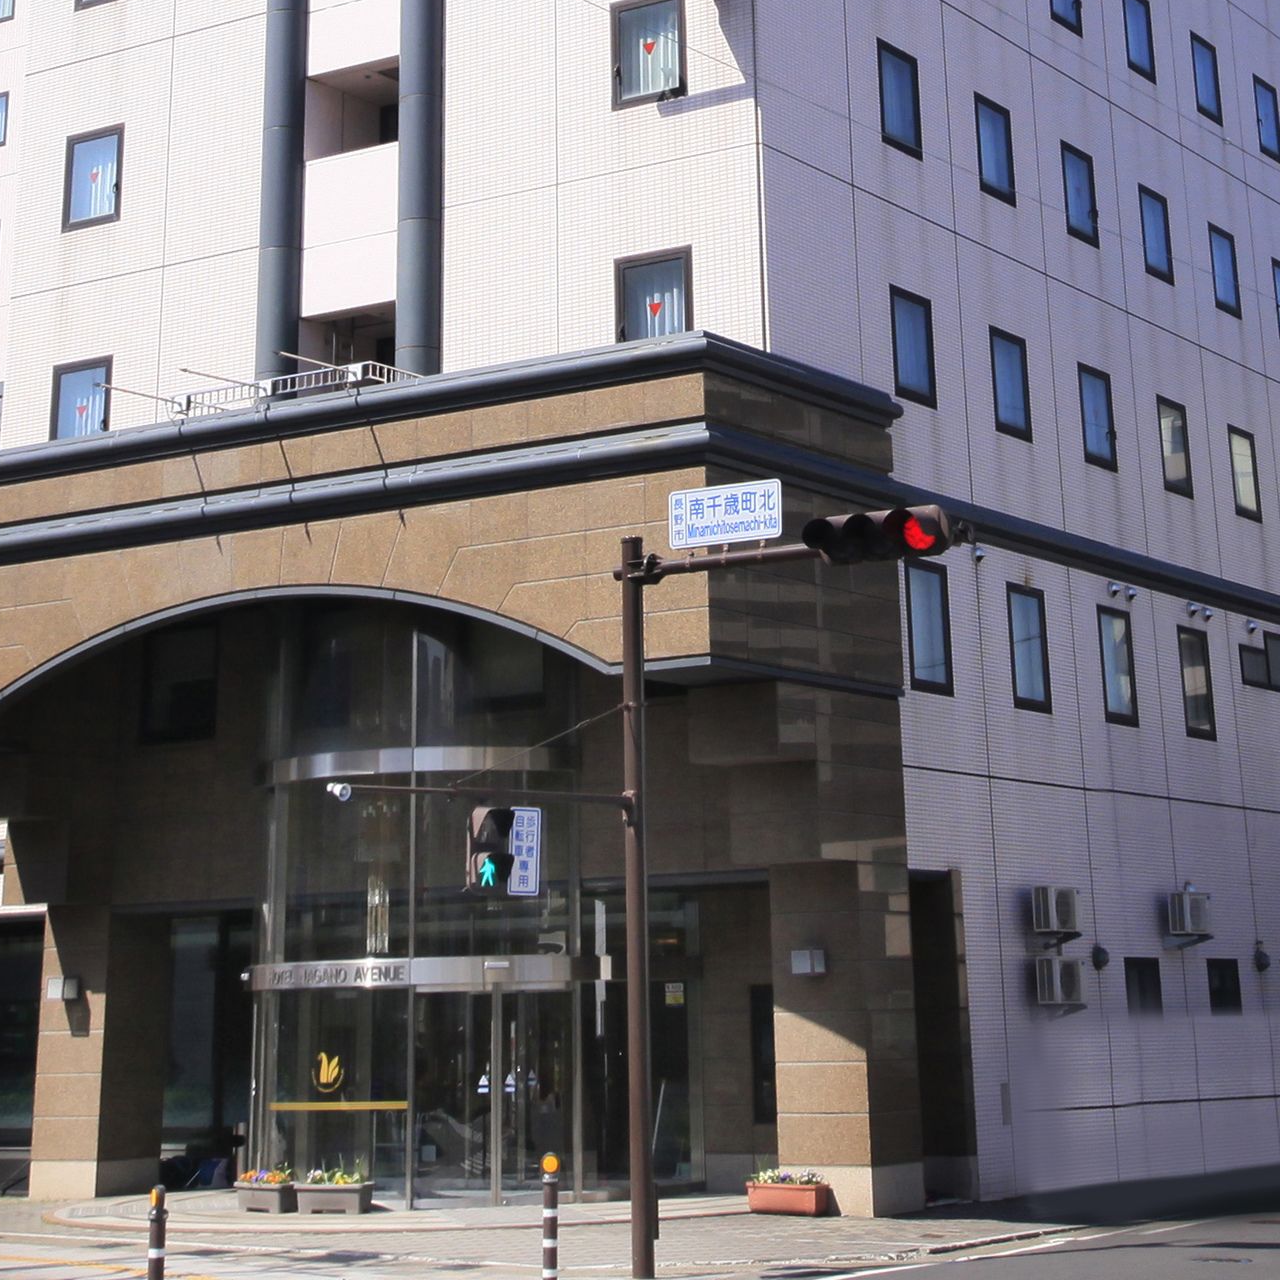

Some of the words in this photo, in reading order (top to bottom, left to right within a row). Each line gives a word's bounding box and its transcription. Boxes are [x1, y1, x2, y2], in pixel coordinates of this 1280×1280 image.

[688, 488, 776, 520] 南千歳町北
[673, 497, 685, 541] 長野市
[687, 513, 778, 539] Minamichitosemachi-kita
[354, 965, 406, 982] AVENUE
